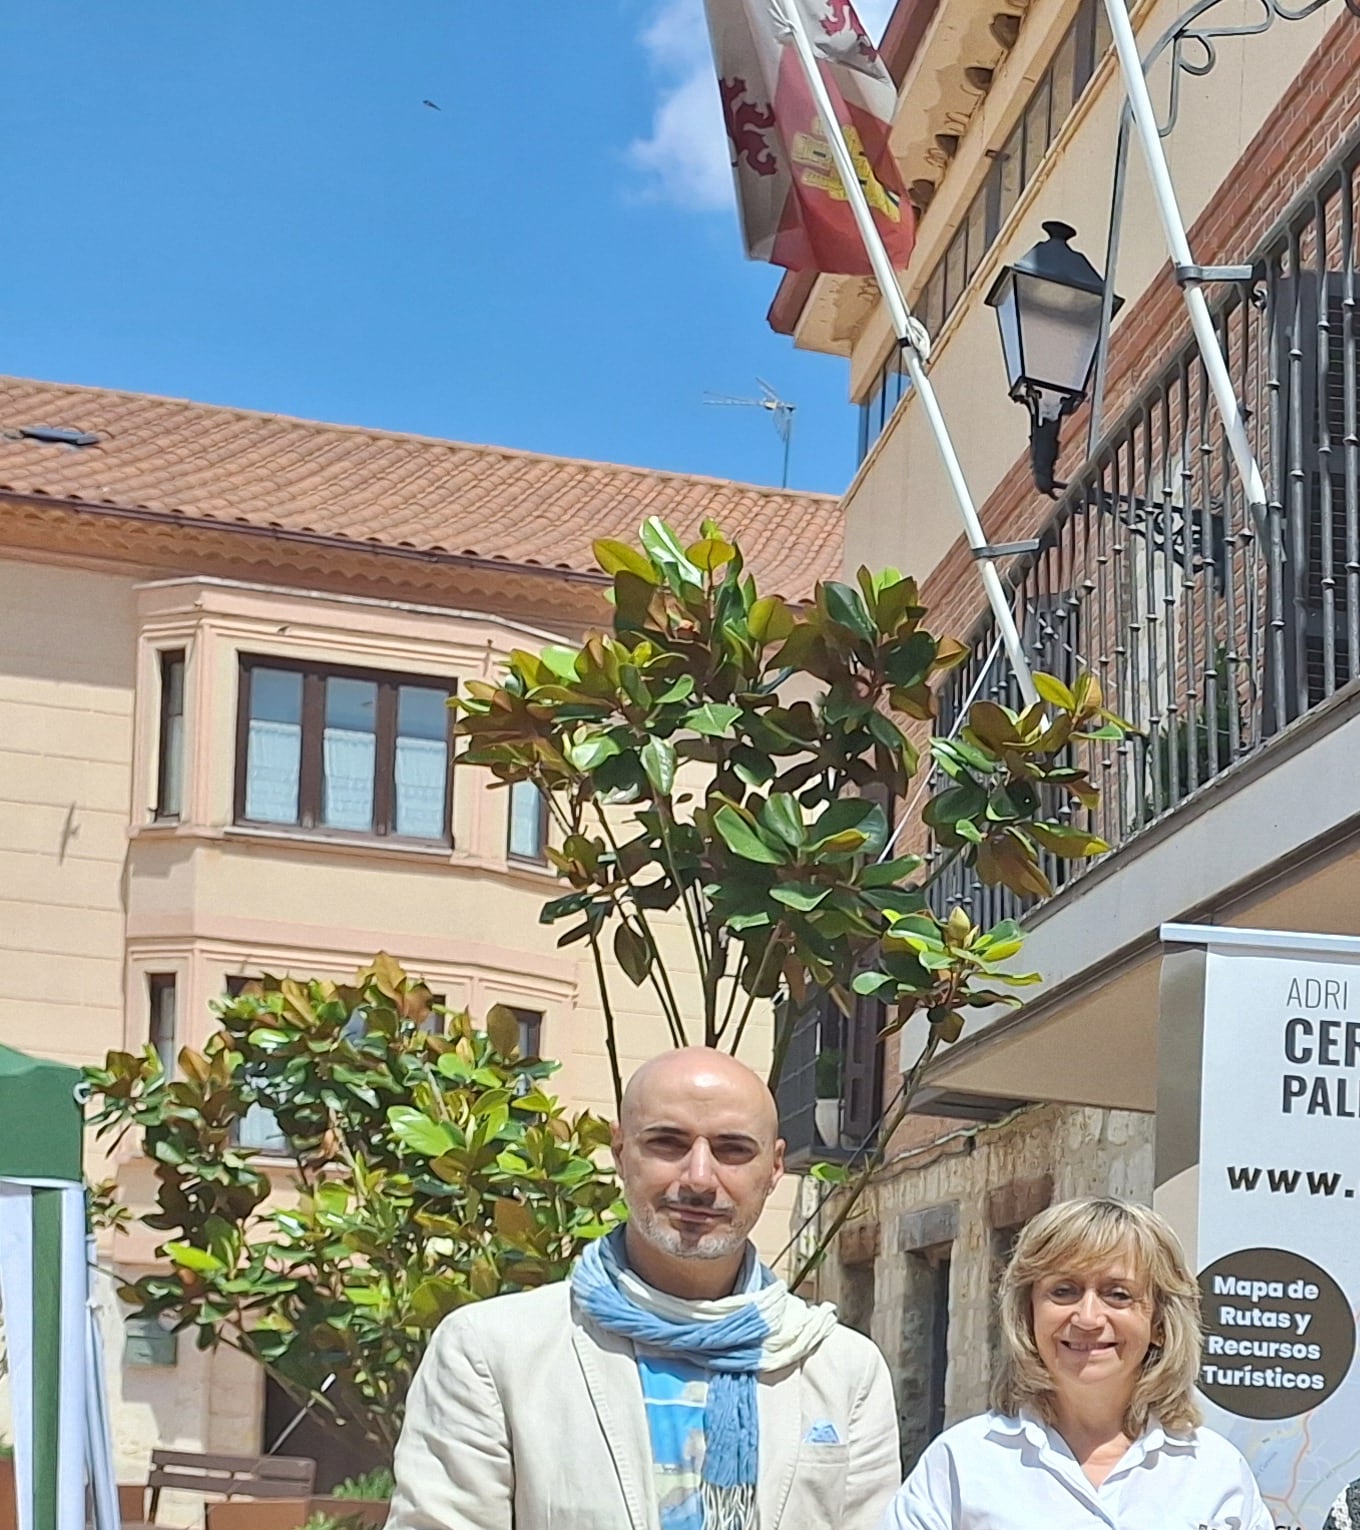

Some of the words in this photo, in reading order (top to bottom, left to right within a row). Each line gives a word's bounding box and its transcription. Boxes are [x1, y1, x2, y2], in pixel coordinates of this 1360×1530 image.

[1286, 978, 1349, 1010] ADRI
[1214, 1275, 1283, 1302] Mapa
[1288, 1280, 1319, 1300] de
[1220, 1306, 1291, 1328] Rutas
[1292, 1313, 1312, 1335] y
[1208, 1336, 1321, 1360] Recursos
[1202, 1365, 1325, 1390] Turísticos
